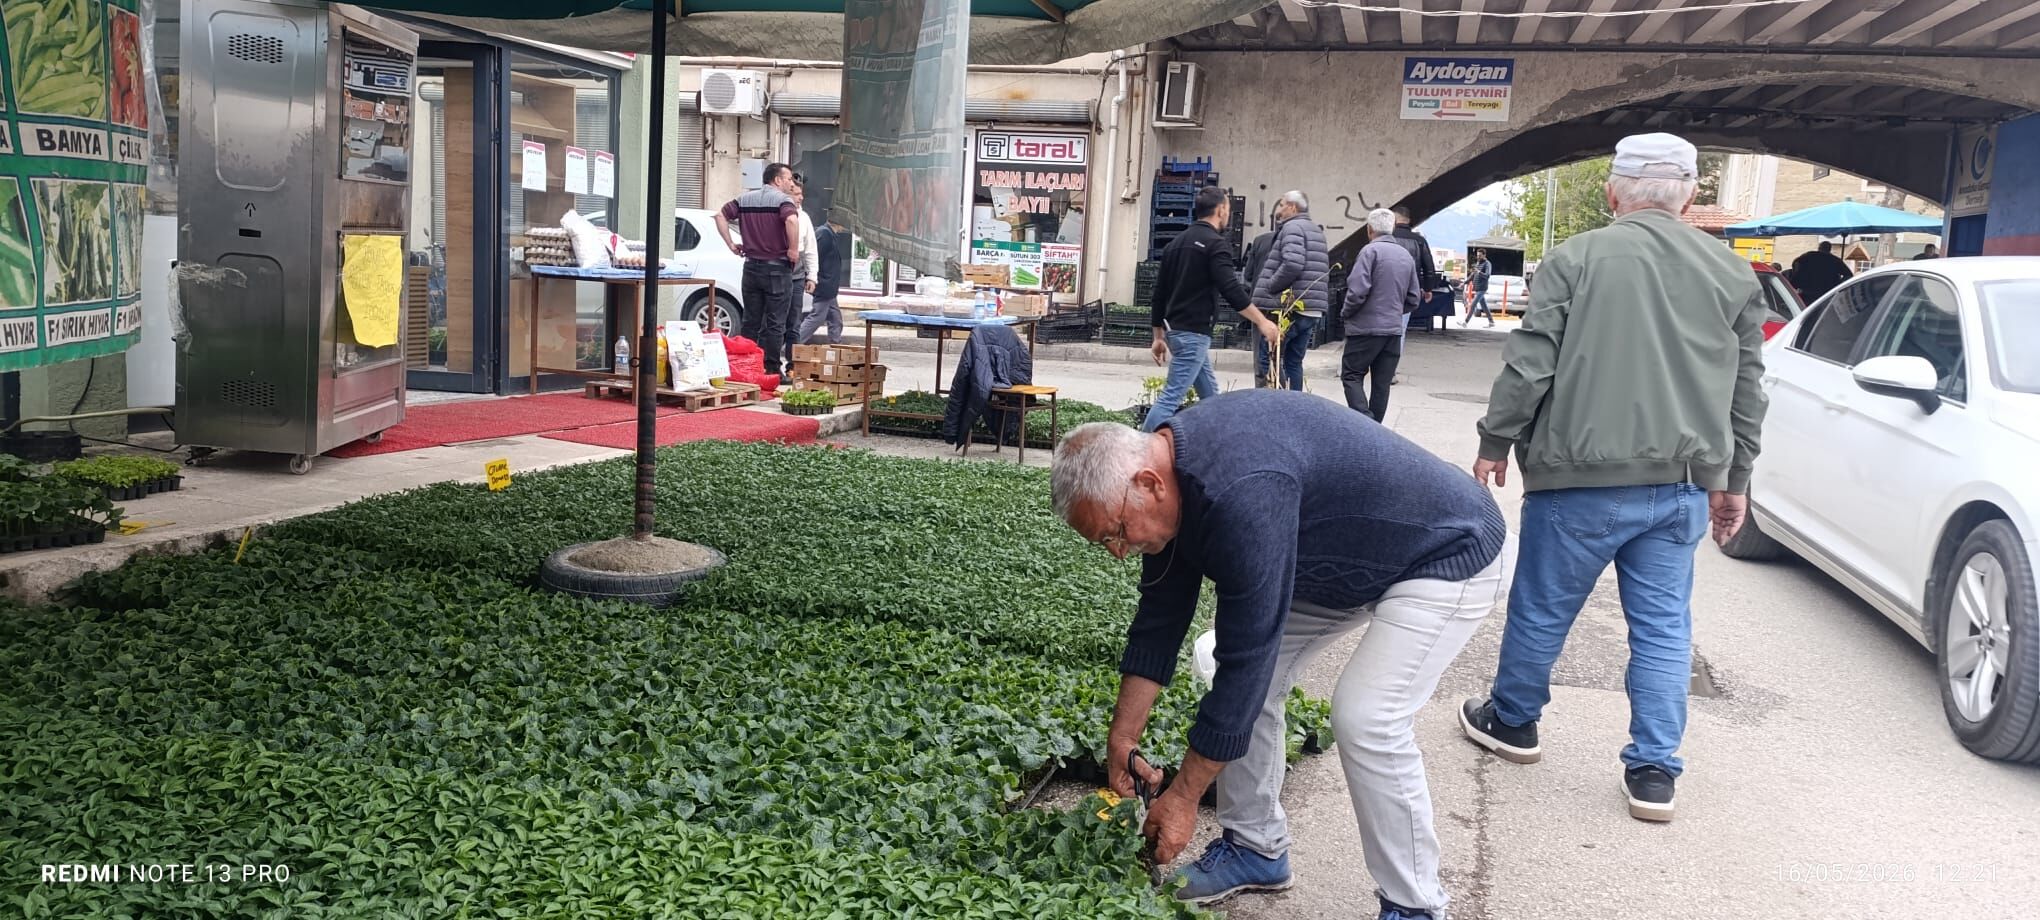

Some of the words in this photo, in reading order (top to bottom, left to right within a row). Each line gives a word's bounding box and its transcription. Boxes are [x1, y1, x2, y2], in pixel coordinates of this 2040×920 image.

[1409, 61, 1508, 84] Aydoğan
[1407, 87, 1453, 97] TULUM
[1455, 87, 1508, 98] PEYNİRİ
[36, 128, 102, 155] BAMYA
[119, 136, 142, 161] ÇİLEK
[1014, 138, 1078, 159] taral
[980, 170, 1021, 188] TARIM
[48, 319, 60, 342] F1
[61, 315, 87, 340] SIRIK
[87, 312, 110, 336] HIYAR
[116, 311, 127, 330] F1
[3, 321, 36, 347] HIYAR
